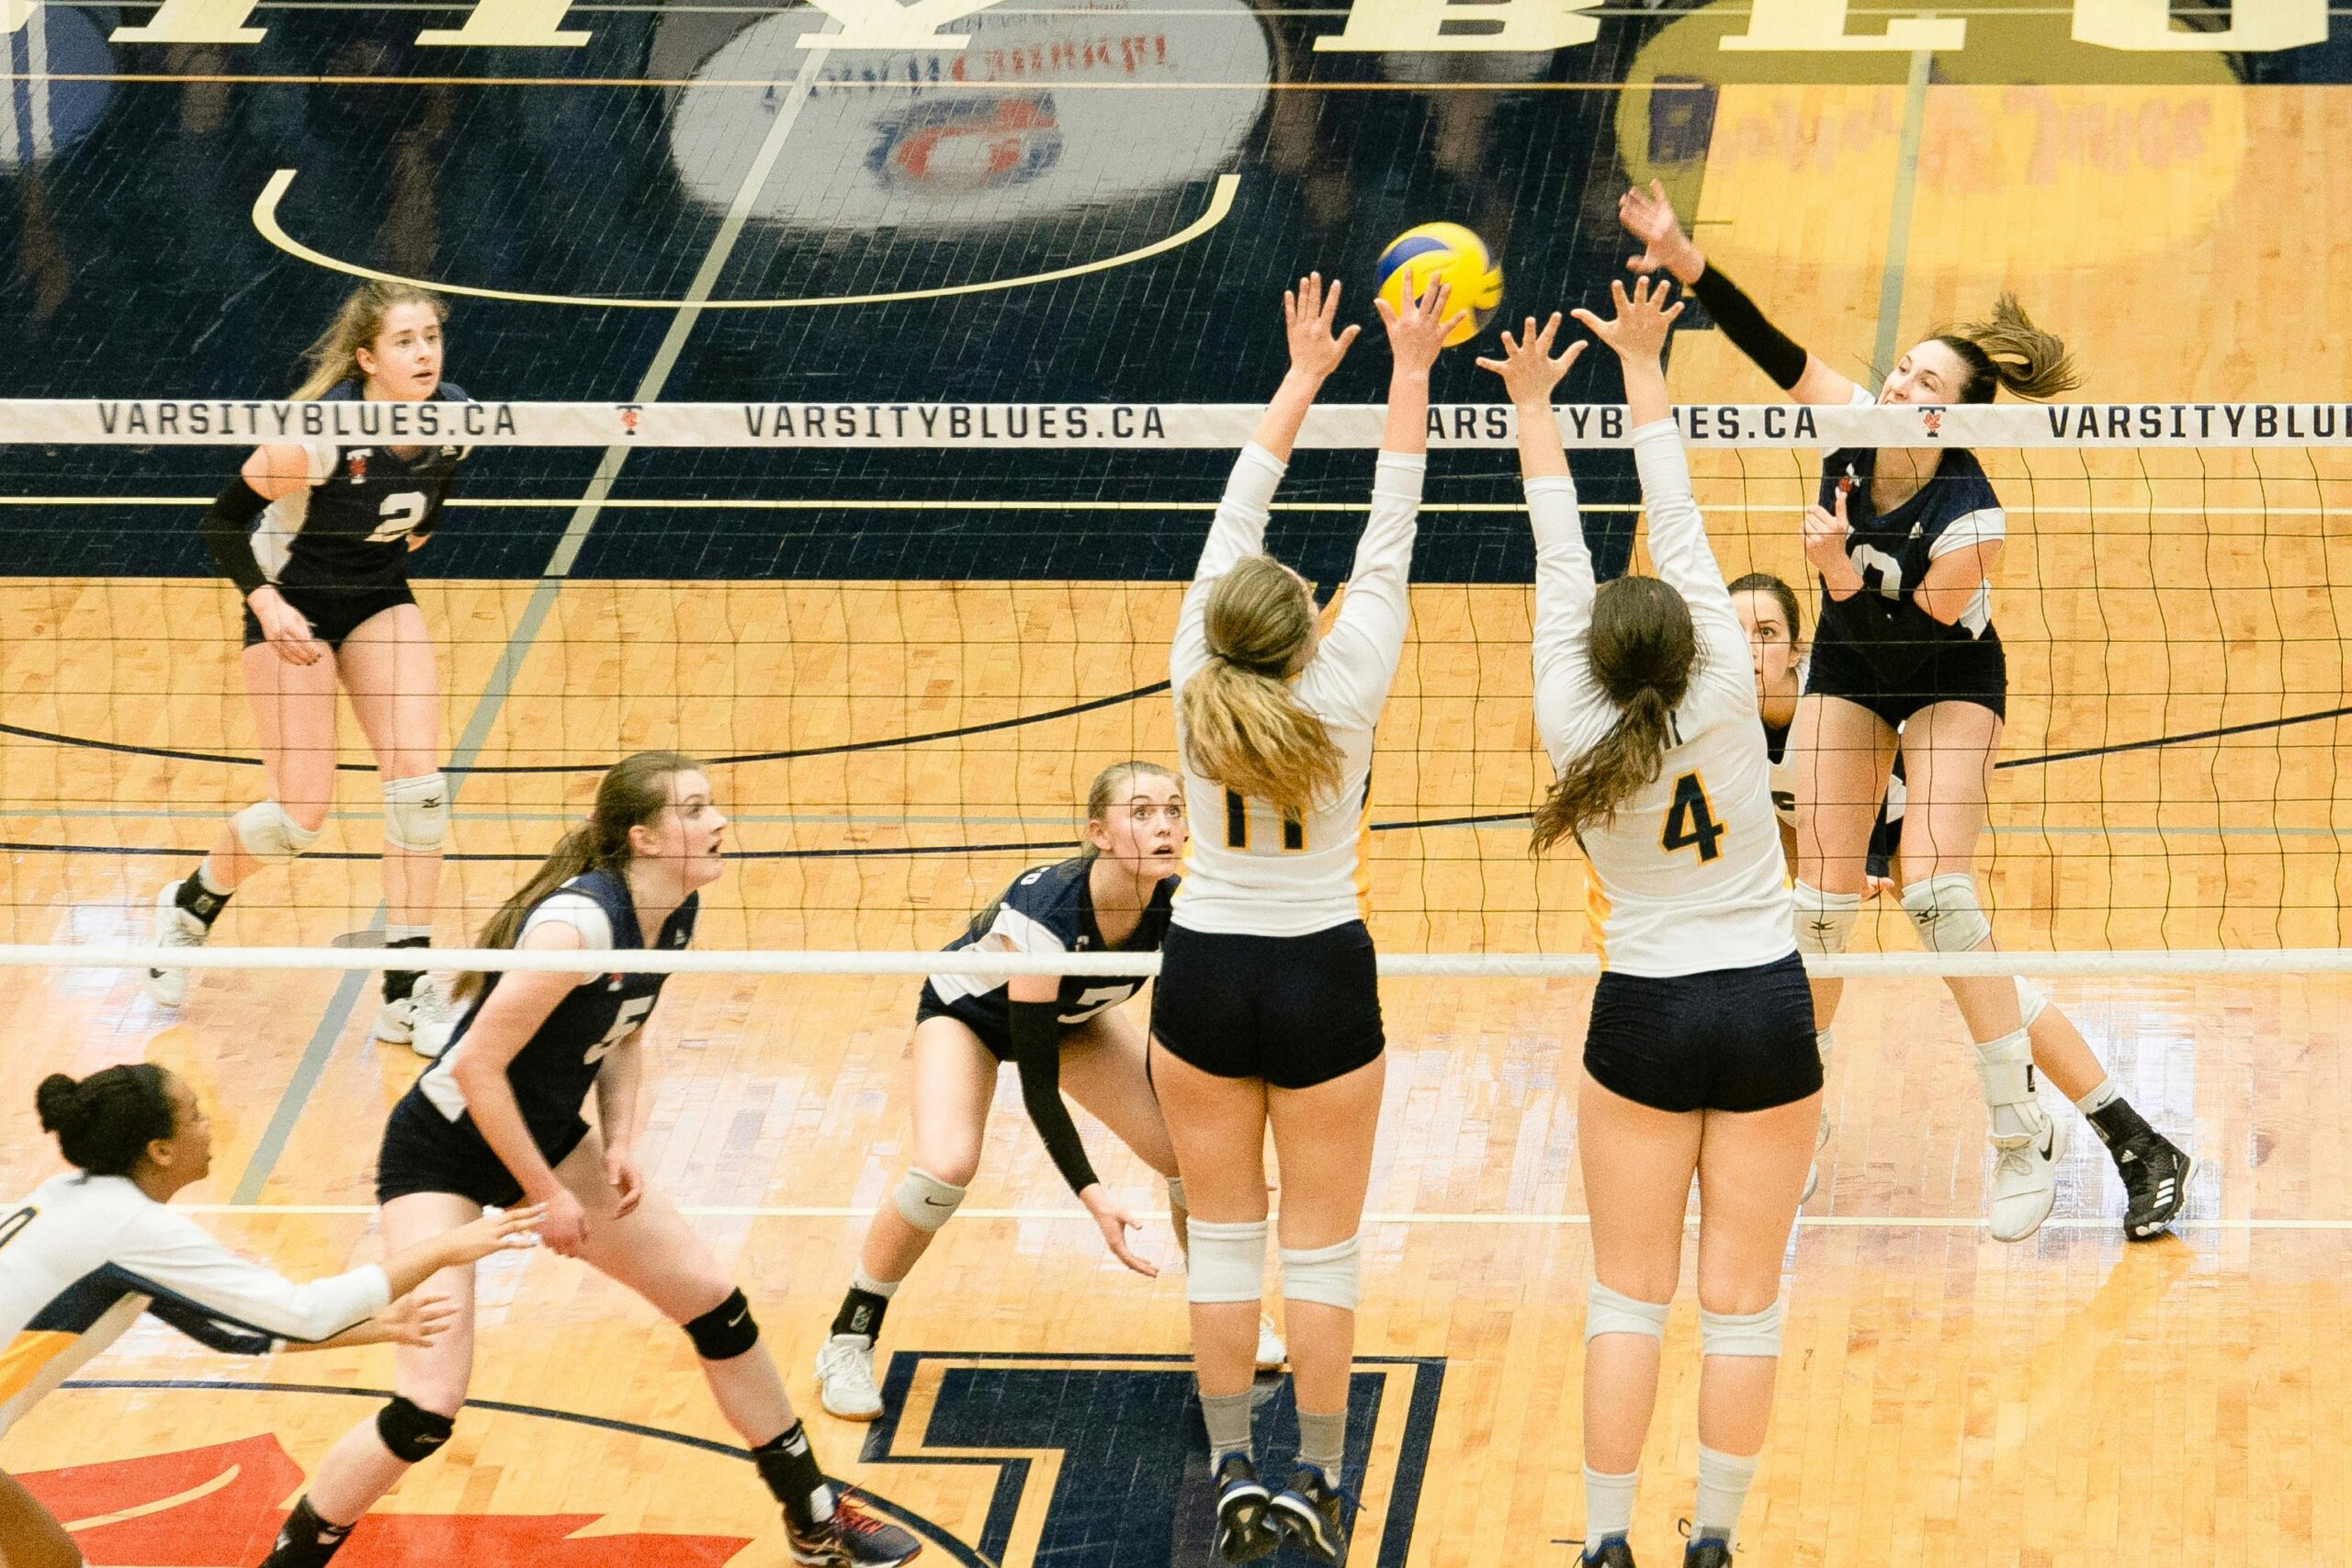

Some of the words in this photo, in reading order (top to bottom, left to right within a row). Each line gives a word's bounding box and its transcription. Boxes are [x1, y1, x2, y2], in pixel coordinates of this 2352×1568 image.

[99, 402, 516, 435] VARSITYBLUES.CA
[745, 404, 1166, 438] VARSITYBLUES.CA
[2048, 405, 2352, 438] VARSITYBLU
[364, 491, 427, 542] 2
[1658, 768, 1729, 866] 4
[1057, 984, 1135, 1023] 7
